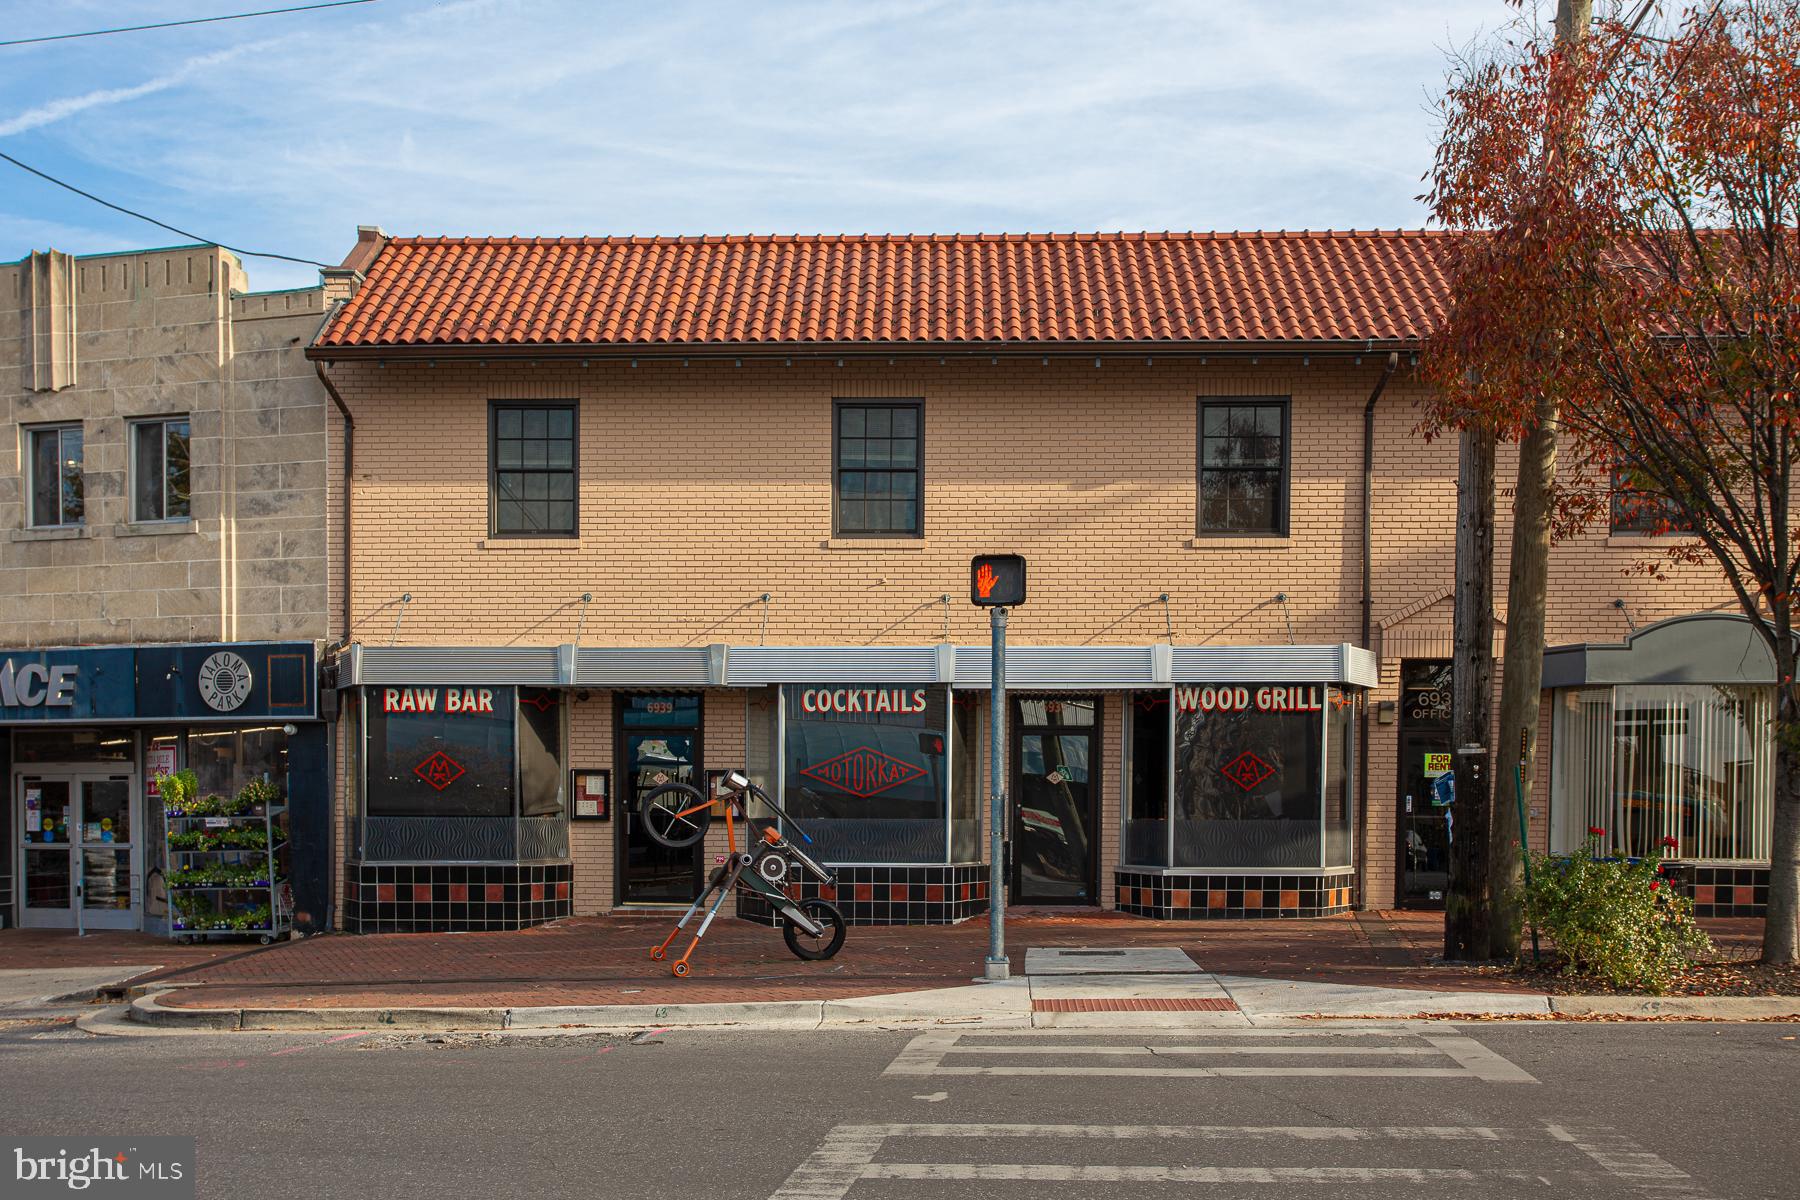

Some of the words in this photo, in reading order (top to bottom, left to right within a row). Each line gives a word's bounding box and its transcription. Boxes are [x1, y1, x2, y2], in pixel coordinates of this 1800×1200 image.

[200, 653, 249, 681] TAKOMA
[0, 658, 79, 707] ACE
[208, 691, 243, 709] PARK
[384, 688, 438, 712] RAW
[445, 688, 494, 712] BAR
[647, 702, 673, 713] 6939
[801, 689, 927, 713] COCKTAILS
[1177, 686, 1249, 711] WOOD
[1254, 686, 1322, 711] GRILL
[1418, 692, 1451, 706] 693
[1412, 709, 1451, 719] OFFIC
[1431, 754, 1449, 762] FOR
[818, 753, 909, 791] MOTORKAT
